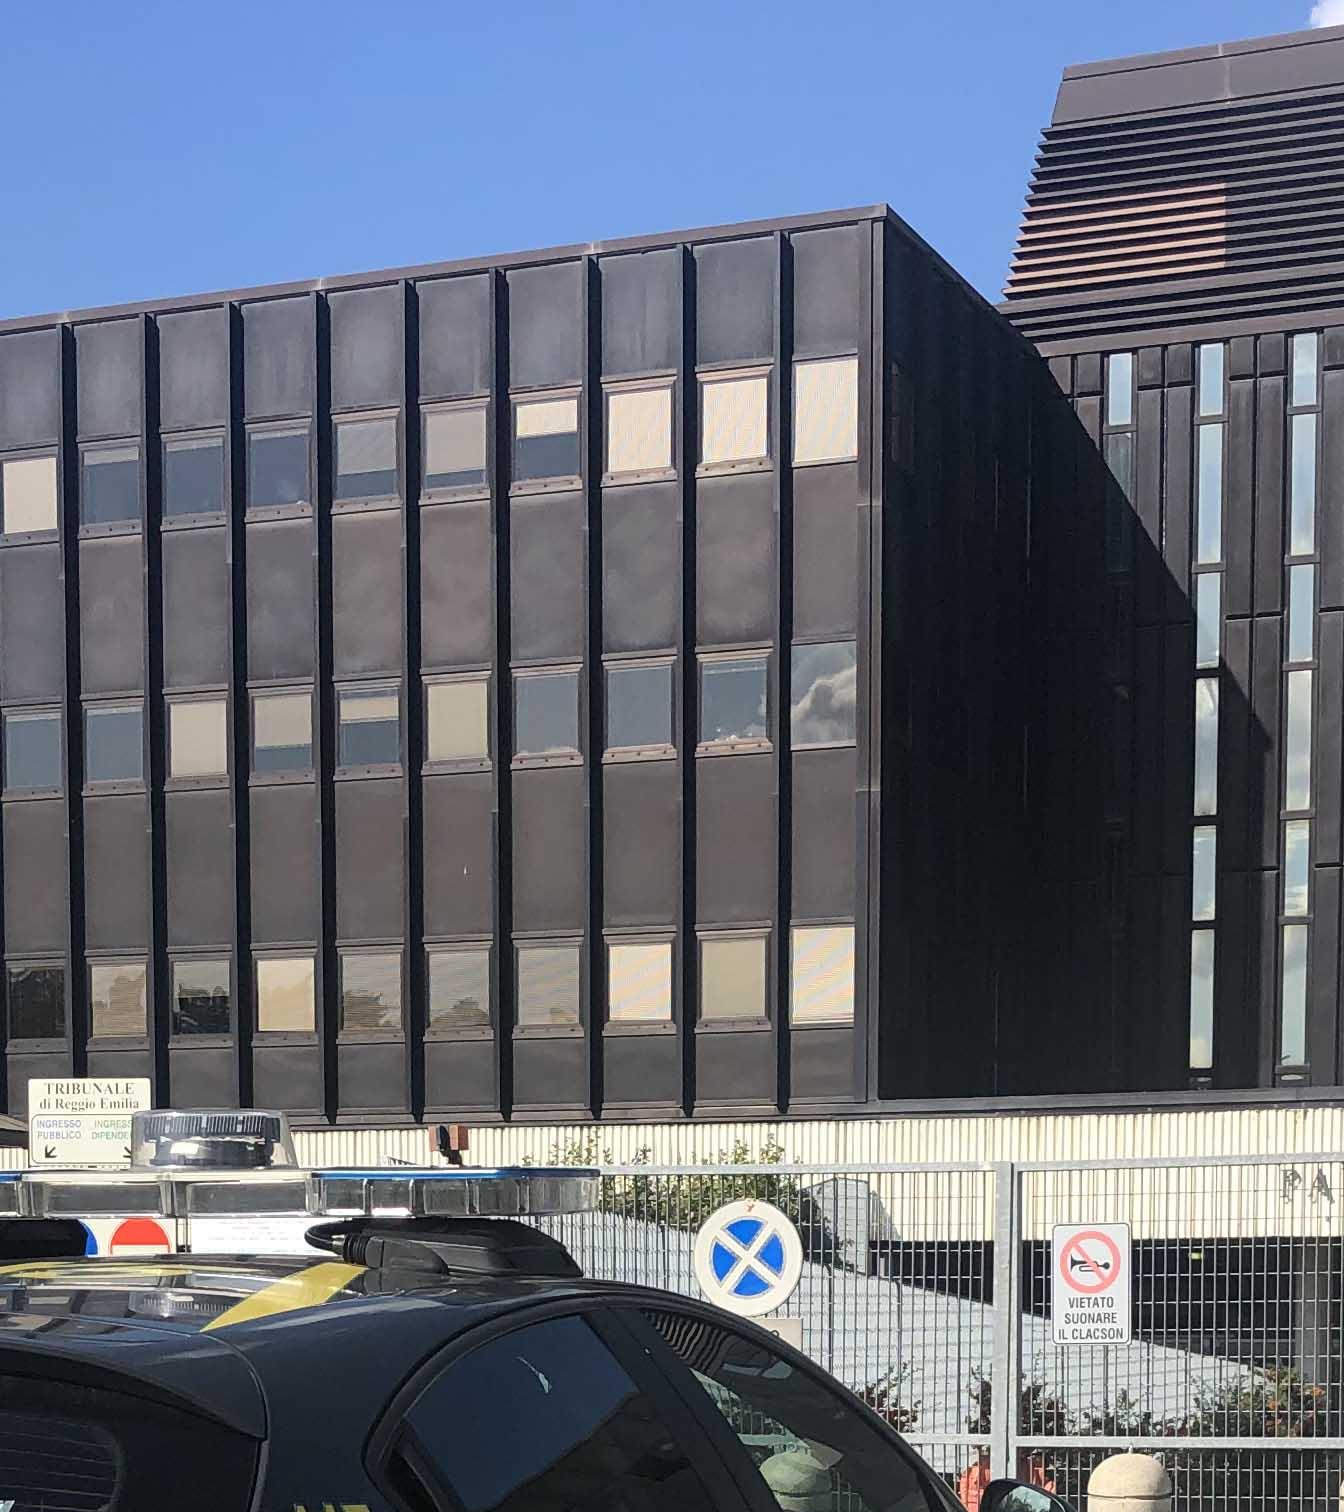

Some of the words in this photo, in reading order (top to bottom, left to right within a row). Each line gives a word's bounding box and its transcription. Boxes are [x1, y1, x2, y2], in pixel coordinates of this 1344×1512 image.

[44, 1082, 135, 1095] TRIBUNALE
[39, 1098, 51, 1109] di
[55, 1098, 96, 1112] Reggio
[100, 1098, 140, 1109] Emilia
[36, 1119, 82, 1128] INGRESSO
[94, 1119, 132, 1128] INGRESS
[37, 1130, 82, 1140] PUBBLICO
[91, 1131, 131, 1140] DIPENDE
[1068, 1296, 1114, 1309] VIETATO
[1064, 1312, 1118, 1325] SUONARE
[1058, 1328, 1068, 1340] IL
[1071, 1327, 1124, 1340] CLACSON
